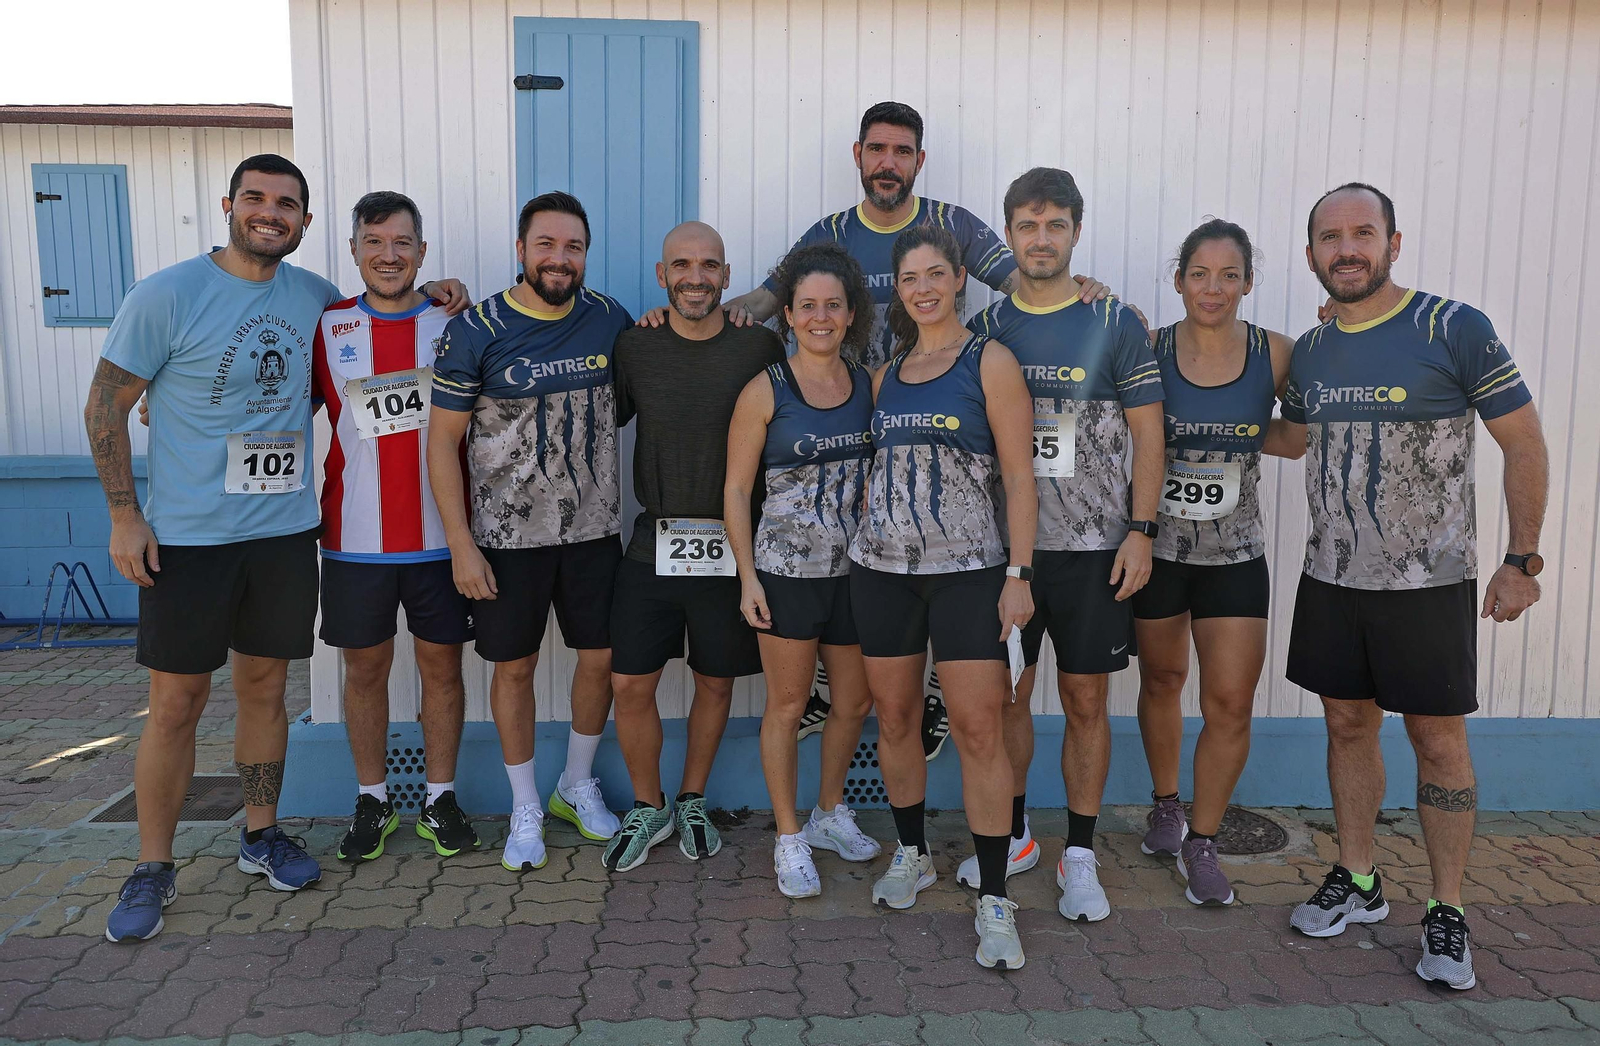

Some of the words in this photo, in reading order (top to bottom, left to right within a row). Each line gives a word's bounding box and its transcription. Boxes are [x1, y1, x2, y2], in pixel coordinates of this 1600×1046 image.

[232, 315, 264, 343] URBANA
[265, 314, 297, 336] CIUDAD
[331, 320, 360, 338] APOLO
[296, 336, 307, 349] DE
[214, 345, 239, 386] CARRERA
[210, 387, 224, 405] XXIV
[362, 386, 384, 395] CIUDAD
[392, 380, 419, 390] ALGECIRAS
[365, 389, 424, 419] 104
[911, 429, 958, 438] COMMUNITY
[243, 452, 296, 476] 102
[1167, 469, 1186, 478] CIUDAD
[1194, 473, 1224, 481] ALGECIRAS
[1164, 479, 1224, 505] 299
[669, 538, 724, 560] 236
